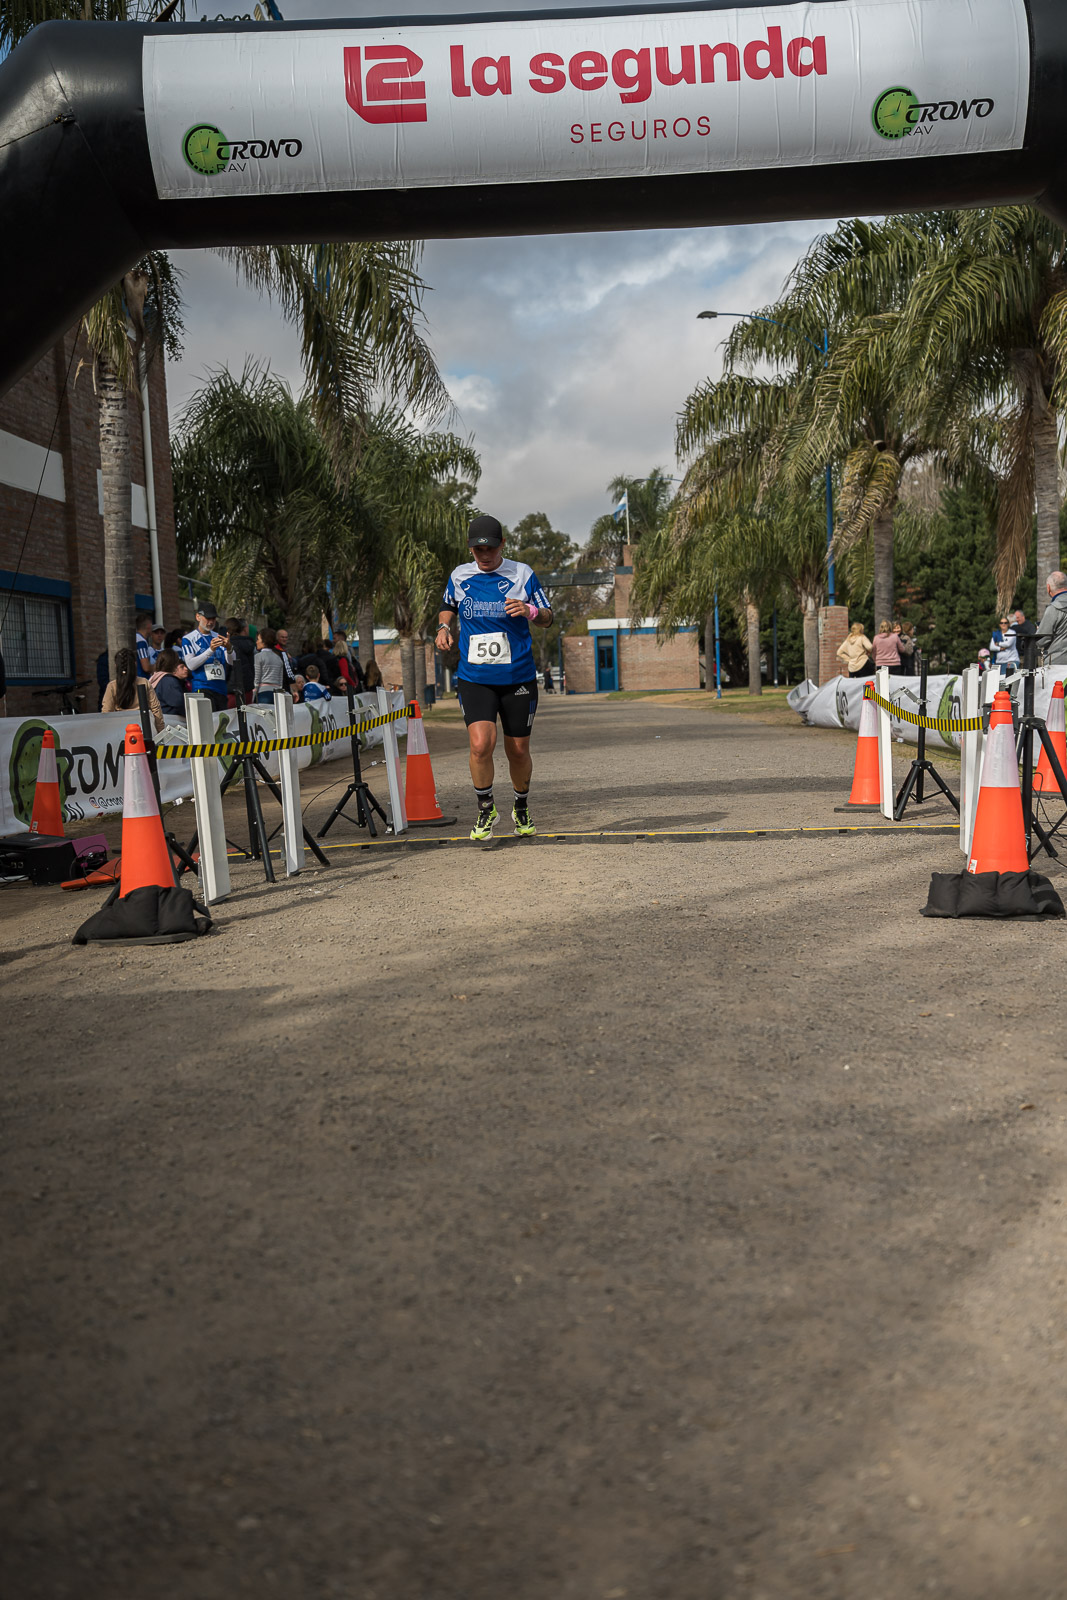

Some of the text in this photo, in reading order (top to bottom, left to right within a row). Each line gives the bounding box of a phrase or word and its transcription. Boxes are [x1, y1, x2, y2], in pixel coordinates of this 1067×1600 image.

[450, 26, 827, 104] la segunda
[905, 98, 994, 123] CRONO
[570, 116, 711, 143] SEGUROS
[902, 125, 934, 137] RAV
[217, 139, 302, 160] CRONO
[217, 162, 247, 173] RAV
[463, 597, 473, 620] 3
[477, 642, 501, 657] 50
[210, 668, 222, 676] 40
